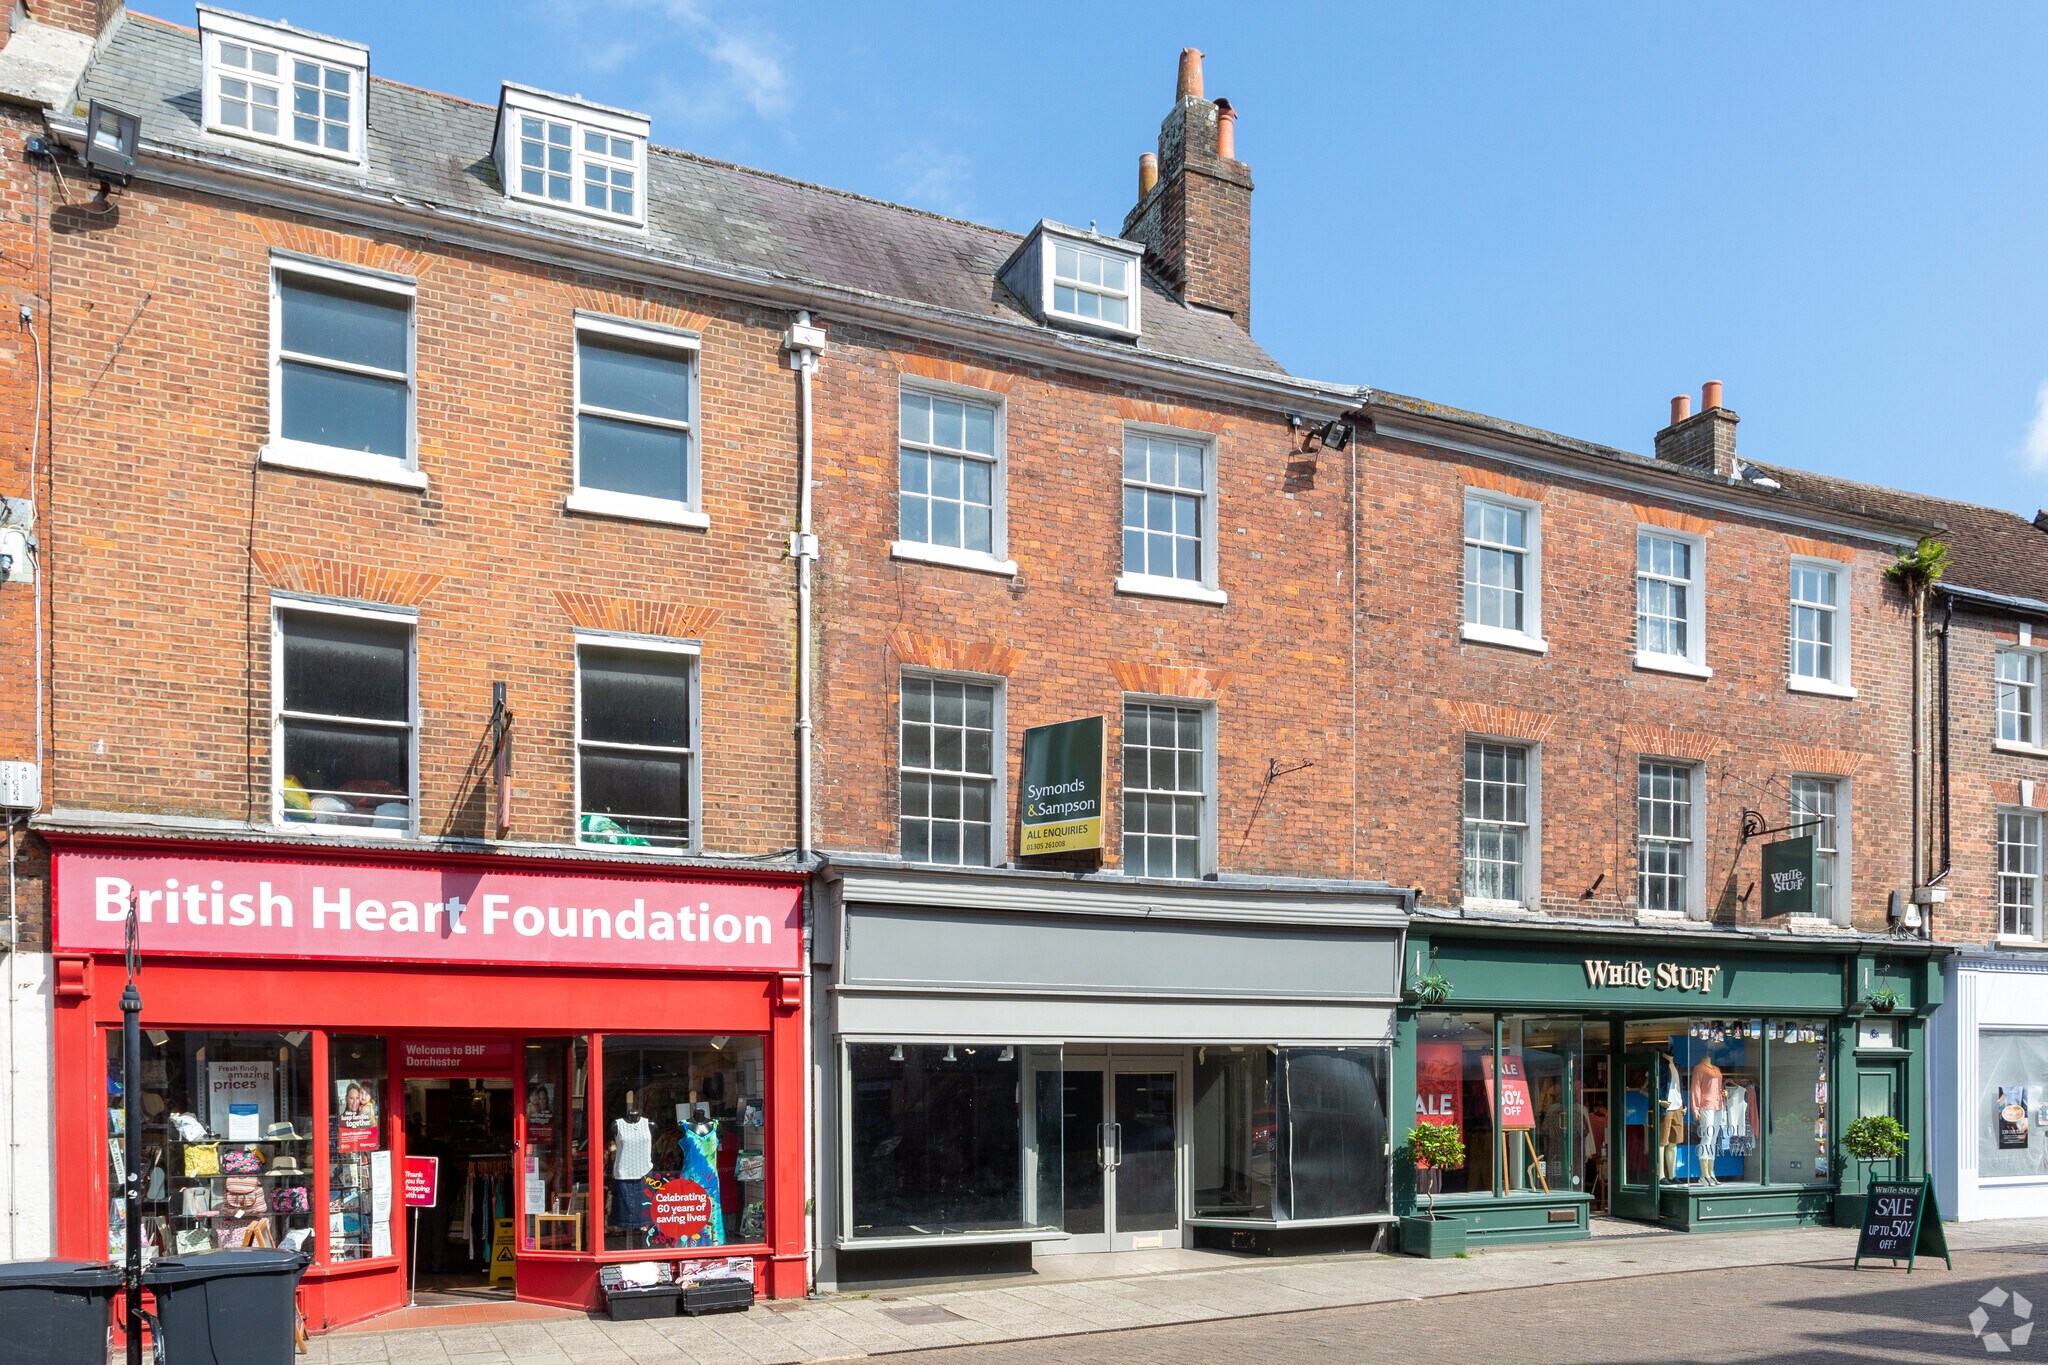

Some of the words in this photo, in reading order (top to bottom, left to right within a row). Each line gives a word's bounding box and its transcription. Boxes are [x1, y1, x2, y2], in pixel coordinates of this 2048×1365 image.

[1028, 779, 1085, 800] Symonds
[1027, 830, 1041, 839] ALL
[1043, 824, 1088, 837] ENQUIRIES
[95, 876, 293, 927] British
[312, 886, 467, 934] Heart
[483, 893, 772, 944] Foundation
[406, 1045, 450, 1054] Welcome
[452, 1046, 463, 1054] to
[465, 1045, 485, 1055] BHF
[406, 1057, 461, 1066] Dorchester
[227, 1071, 269, 1080] amazing
[213, 1079, 257, 1093] prices
[1416, 1094, 1452, 1115] ALE
[1504, 1107, 1521, 1116] OFF
[1697, 1125, 1715, 1137] GO
[1695, 1144, 1725, 1157] OWN
[1729, 1143, 1753, 1157] WAY
[405, 1185, 430, 1193] hopping
[656, 1192, 706, 1203] Celebrating
[657, 1204, 670, 1213] 60
[671, 1205, 694, 1214] years
[696, 1202, 706, 1211] of
[1875, 1198, 1913, 1216] SALE
[656, 1215, 685, 1224] saving
[687, 1213, 706, 1222] lives
[1869, 1225, 1879, 1235] UP
[1880, 1225, 1889, 1235] TO
[1890, 1220, 1914, 1237] 50%
[1880, 1240, 1897, 1249] OFF!
